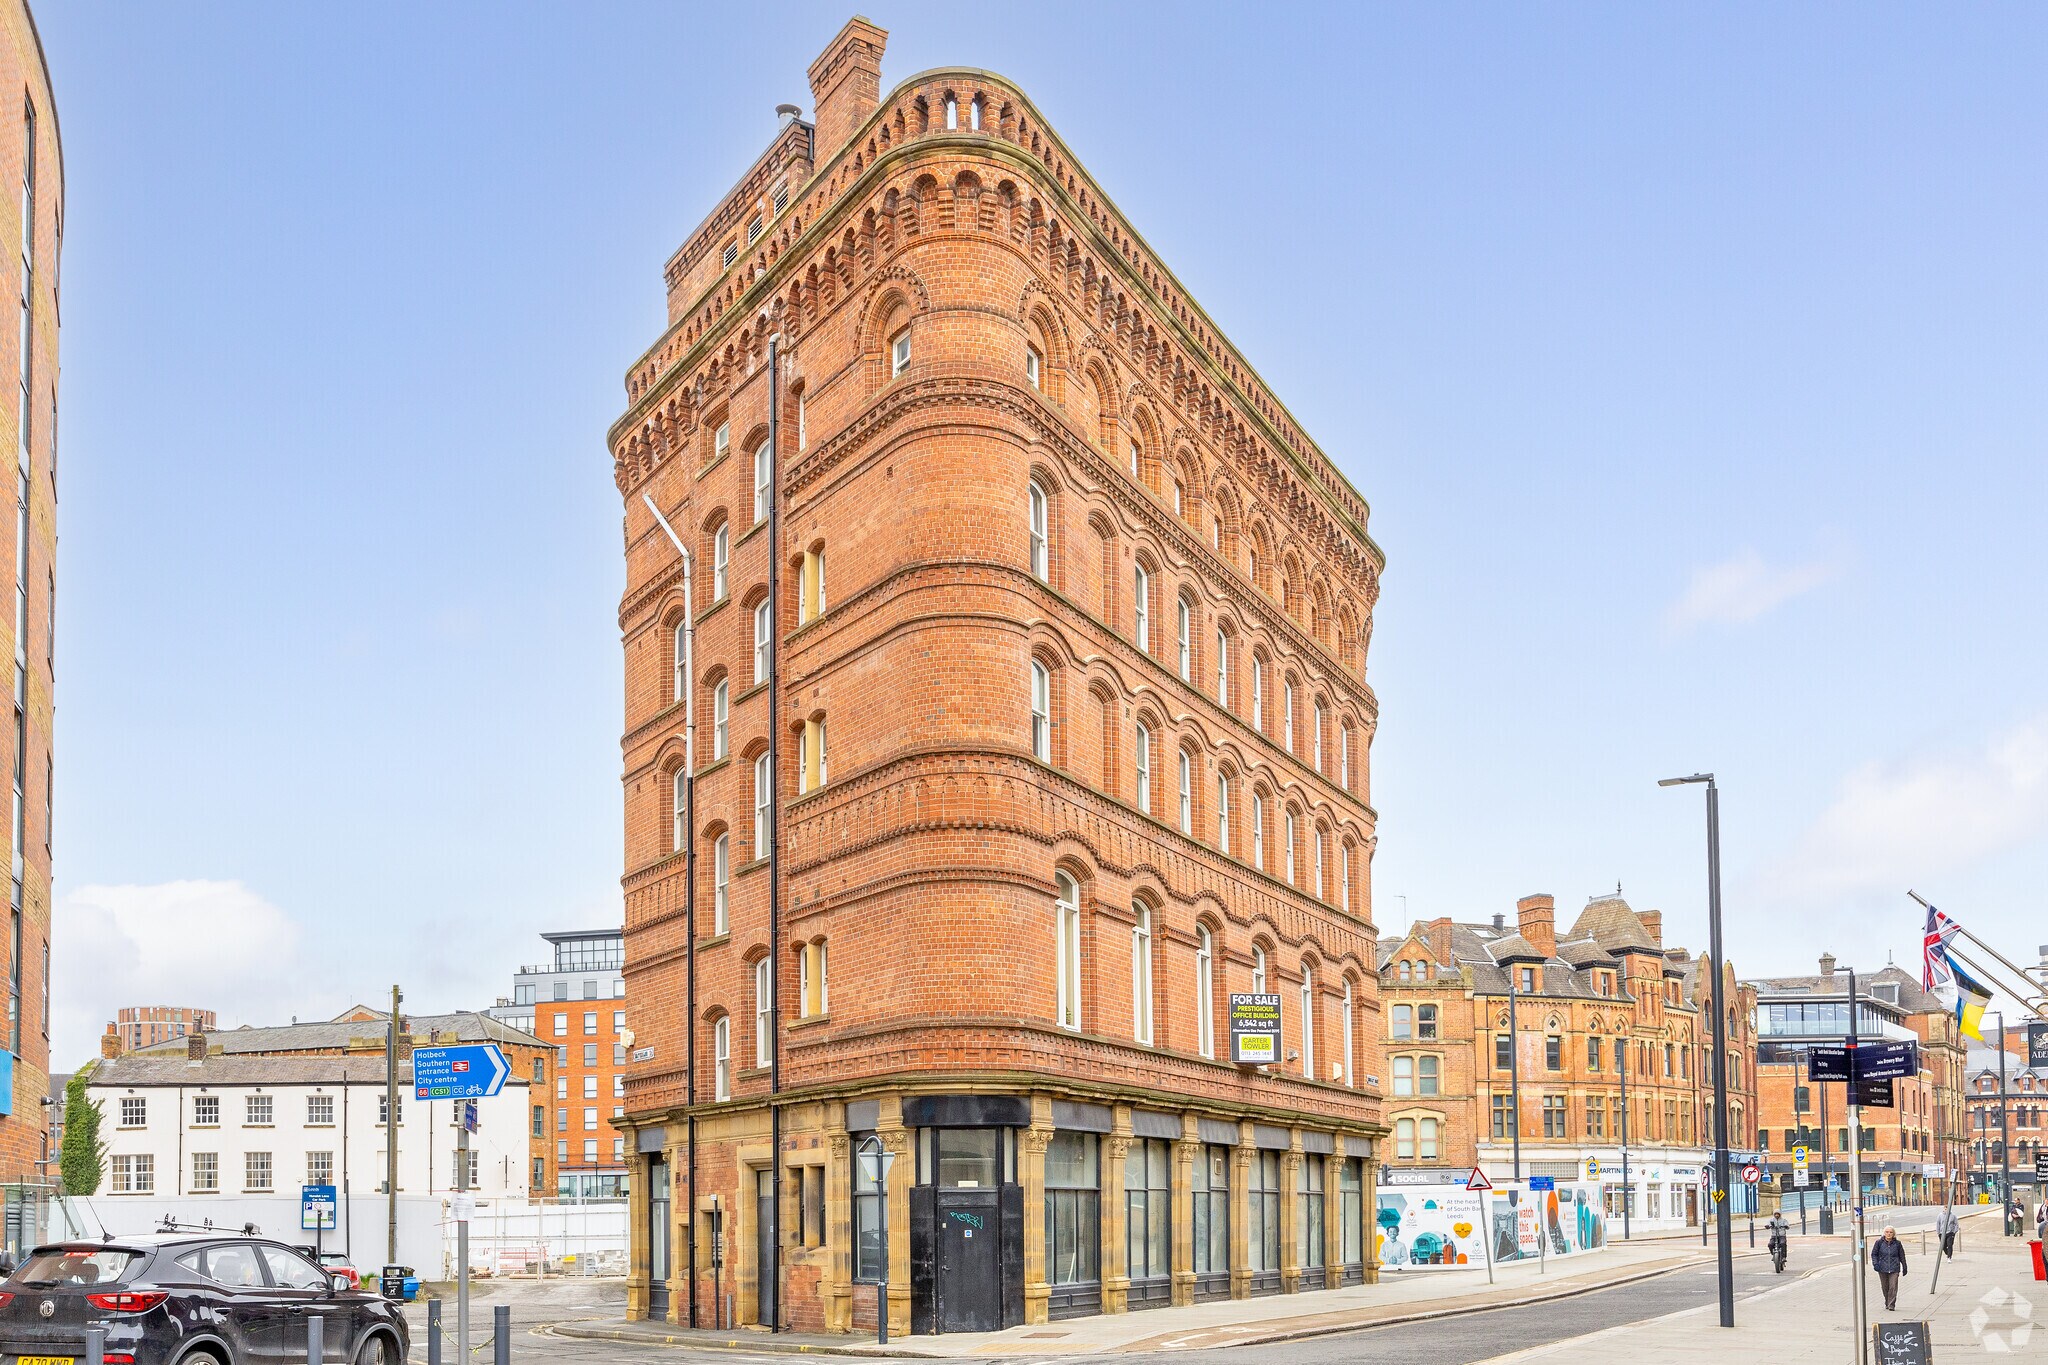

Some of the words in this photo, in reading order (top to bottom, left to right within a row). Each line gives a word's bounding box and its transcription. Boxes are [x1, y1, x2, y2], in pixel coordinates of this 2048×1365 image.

[1232, 995, 1252, 1004] FOR
[1255, 996, 1278, 1005] SALE
[1519, 1206, 1533, 1218] watch
[1519, 1220, 1529, 1232] this
